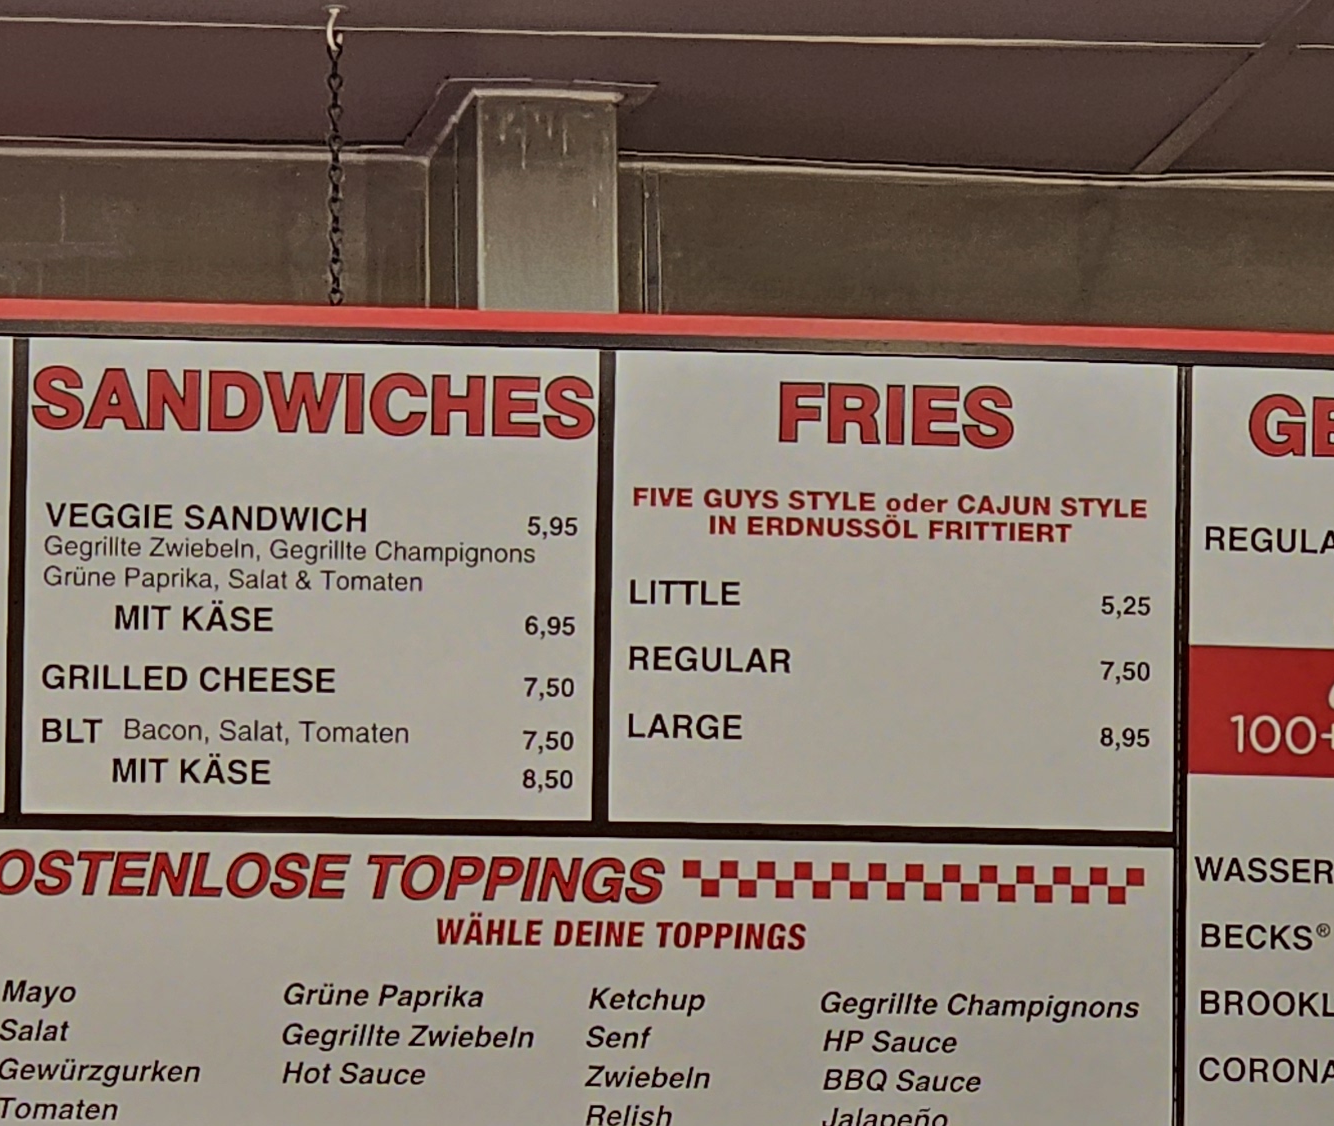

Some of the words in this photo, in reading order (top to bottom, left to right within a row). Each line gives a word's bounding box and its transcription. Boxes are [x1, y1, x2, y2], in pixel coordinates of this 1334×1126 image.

[31, 366, 595, 440] SANDWICHES
[779, 381, 1014, 449] FRIES
[634, 487, 692, 507] FIVE
[704, 489, 778, 509] GUYS
[789, 490, 875, 511] STYLE
[886, 493, 948, 512] oder
[958, 494, 1050, 515] CAJUN
[1061, 497, 1147, 518] STYLE
[46, 502, 172, 529] VEGGIE
[185, 505, 366, 532] SANDWICH
[528, 516, 577, 539] 5,95
[710, 515, 736, 534] IN
[748, 514, 918, 538] ERDNUSSÖL
[929, 520, 1072, 542] FRITTIERT
[45, 535, 141, 561] Gegrillte
[149, 537, 260, 561] Zwiebeln,
[270, 539, 366, 565] Gegrillte
[376, 541, 535, 567] Champignons
[44, 565, 115, 586] Grüne
[125, 567, 218, 592] Paprika,
[229, 569, 287, 589] Salat
[296, 570, 311, 590] &
[320, 570, 422, 591] Tomaten
[630, 580, 740, 605] LITTLE
[1102, 596, 1150, 618] 5,25
[115, 605, 171, 630] MIT
[183, 600, 273, 631] KÄSE
[525, 616, 575, 639] 6,95
[42, 664, 187, 690] GRILLED
[200, 667, 335, 693] CHEESE
[524, 677, 574, 700] 7,50
[42, 719, 102, 743] BLT
[124, 719, 208, 744] Bacon,
[220, 720, 288, 745] Salat,
[299, 721, 408, 743] Tomaten
[523, 730, 573, 754] 7,50
[629, 714, 742, 739] LARGE
[1100, 728, 1149, 750] 8,95
[367, 855, 665, 904] TOPPINGS
[1195, 857, 1333, 884] WASSER
[437, 912, 543, 945] WÄHLE
[554, 921, 644, 947] DEINE
[657, 921, 807, 951] TOPPINGS
[2, 980, 76, 1008] Mayo
[284, 983, 368, 1006] Grüne
[379, 984, 483, 1012] Paprika
[589, 988, 705, 1017] Ketchup
[821, 992, 937, 1019] Gegrillte
[948, 993, 1139, 1023] Champignons
[586, 1026, 652, 1048] Senf
[824, 1030, 863, 1051] HP
[872, 1030, 957, 1053] Sauce
[585, 1065, 710, 1088] Zwiebeln
[823, 1069, 887, 1091] BBQ
[896, 1069, 981, 1092] Sauce
[586, 1105, 672, 1126] Relish
